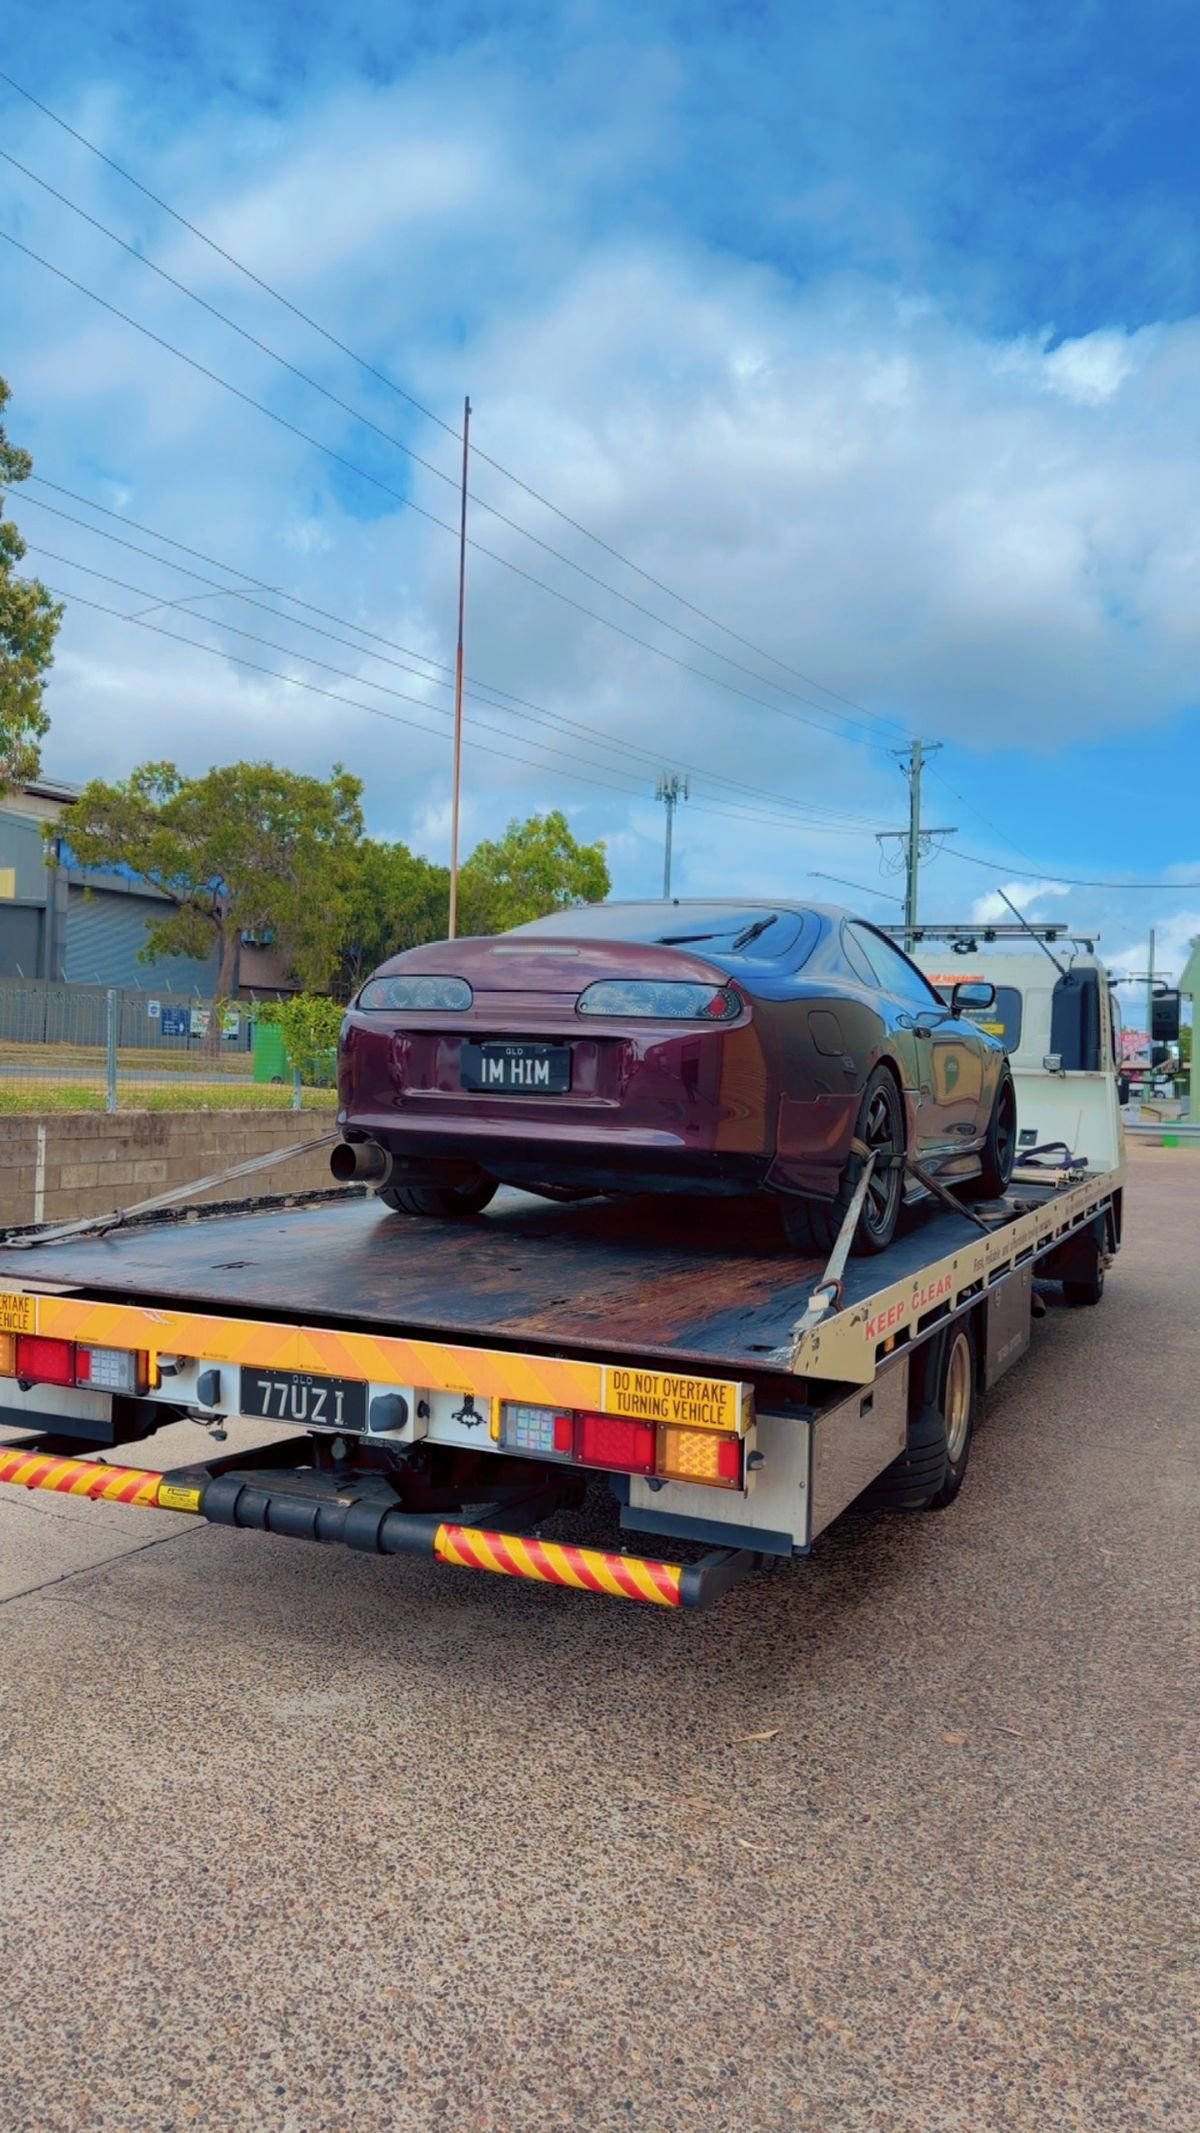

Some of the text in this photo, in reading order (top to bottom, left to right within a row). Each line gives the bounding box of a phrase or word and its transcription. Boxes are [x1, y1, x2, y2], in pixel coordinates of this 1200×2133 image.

[505, 1047, 524, 1056] QLD
[511, 1058, 550, 1085] HIM
[865, 1274, 953, 1341] KEEP CLEAR
[292, 1374, 313, 1385] QLD
[613, 1371, 727, 1404] DO NOT OVERTAKE
[617, 1392, 725, 1425] TURNING VEHICLE
